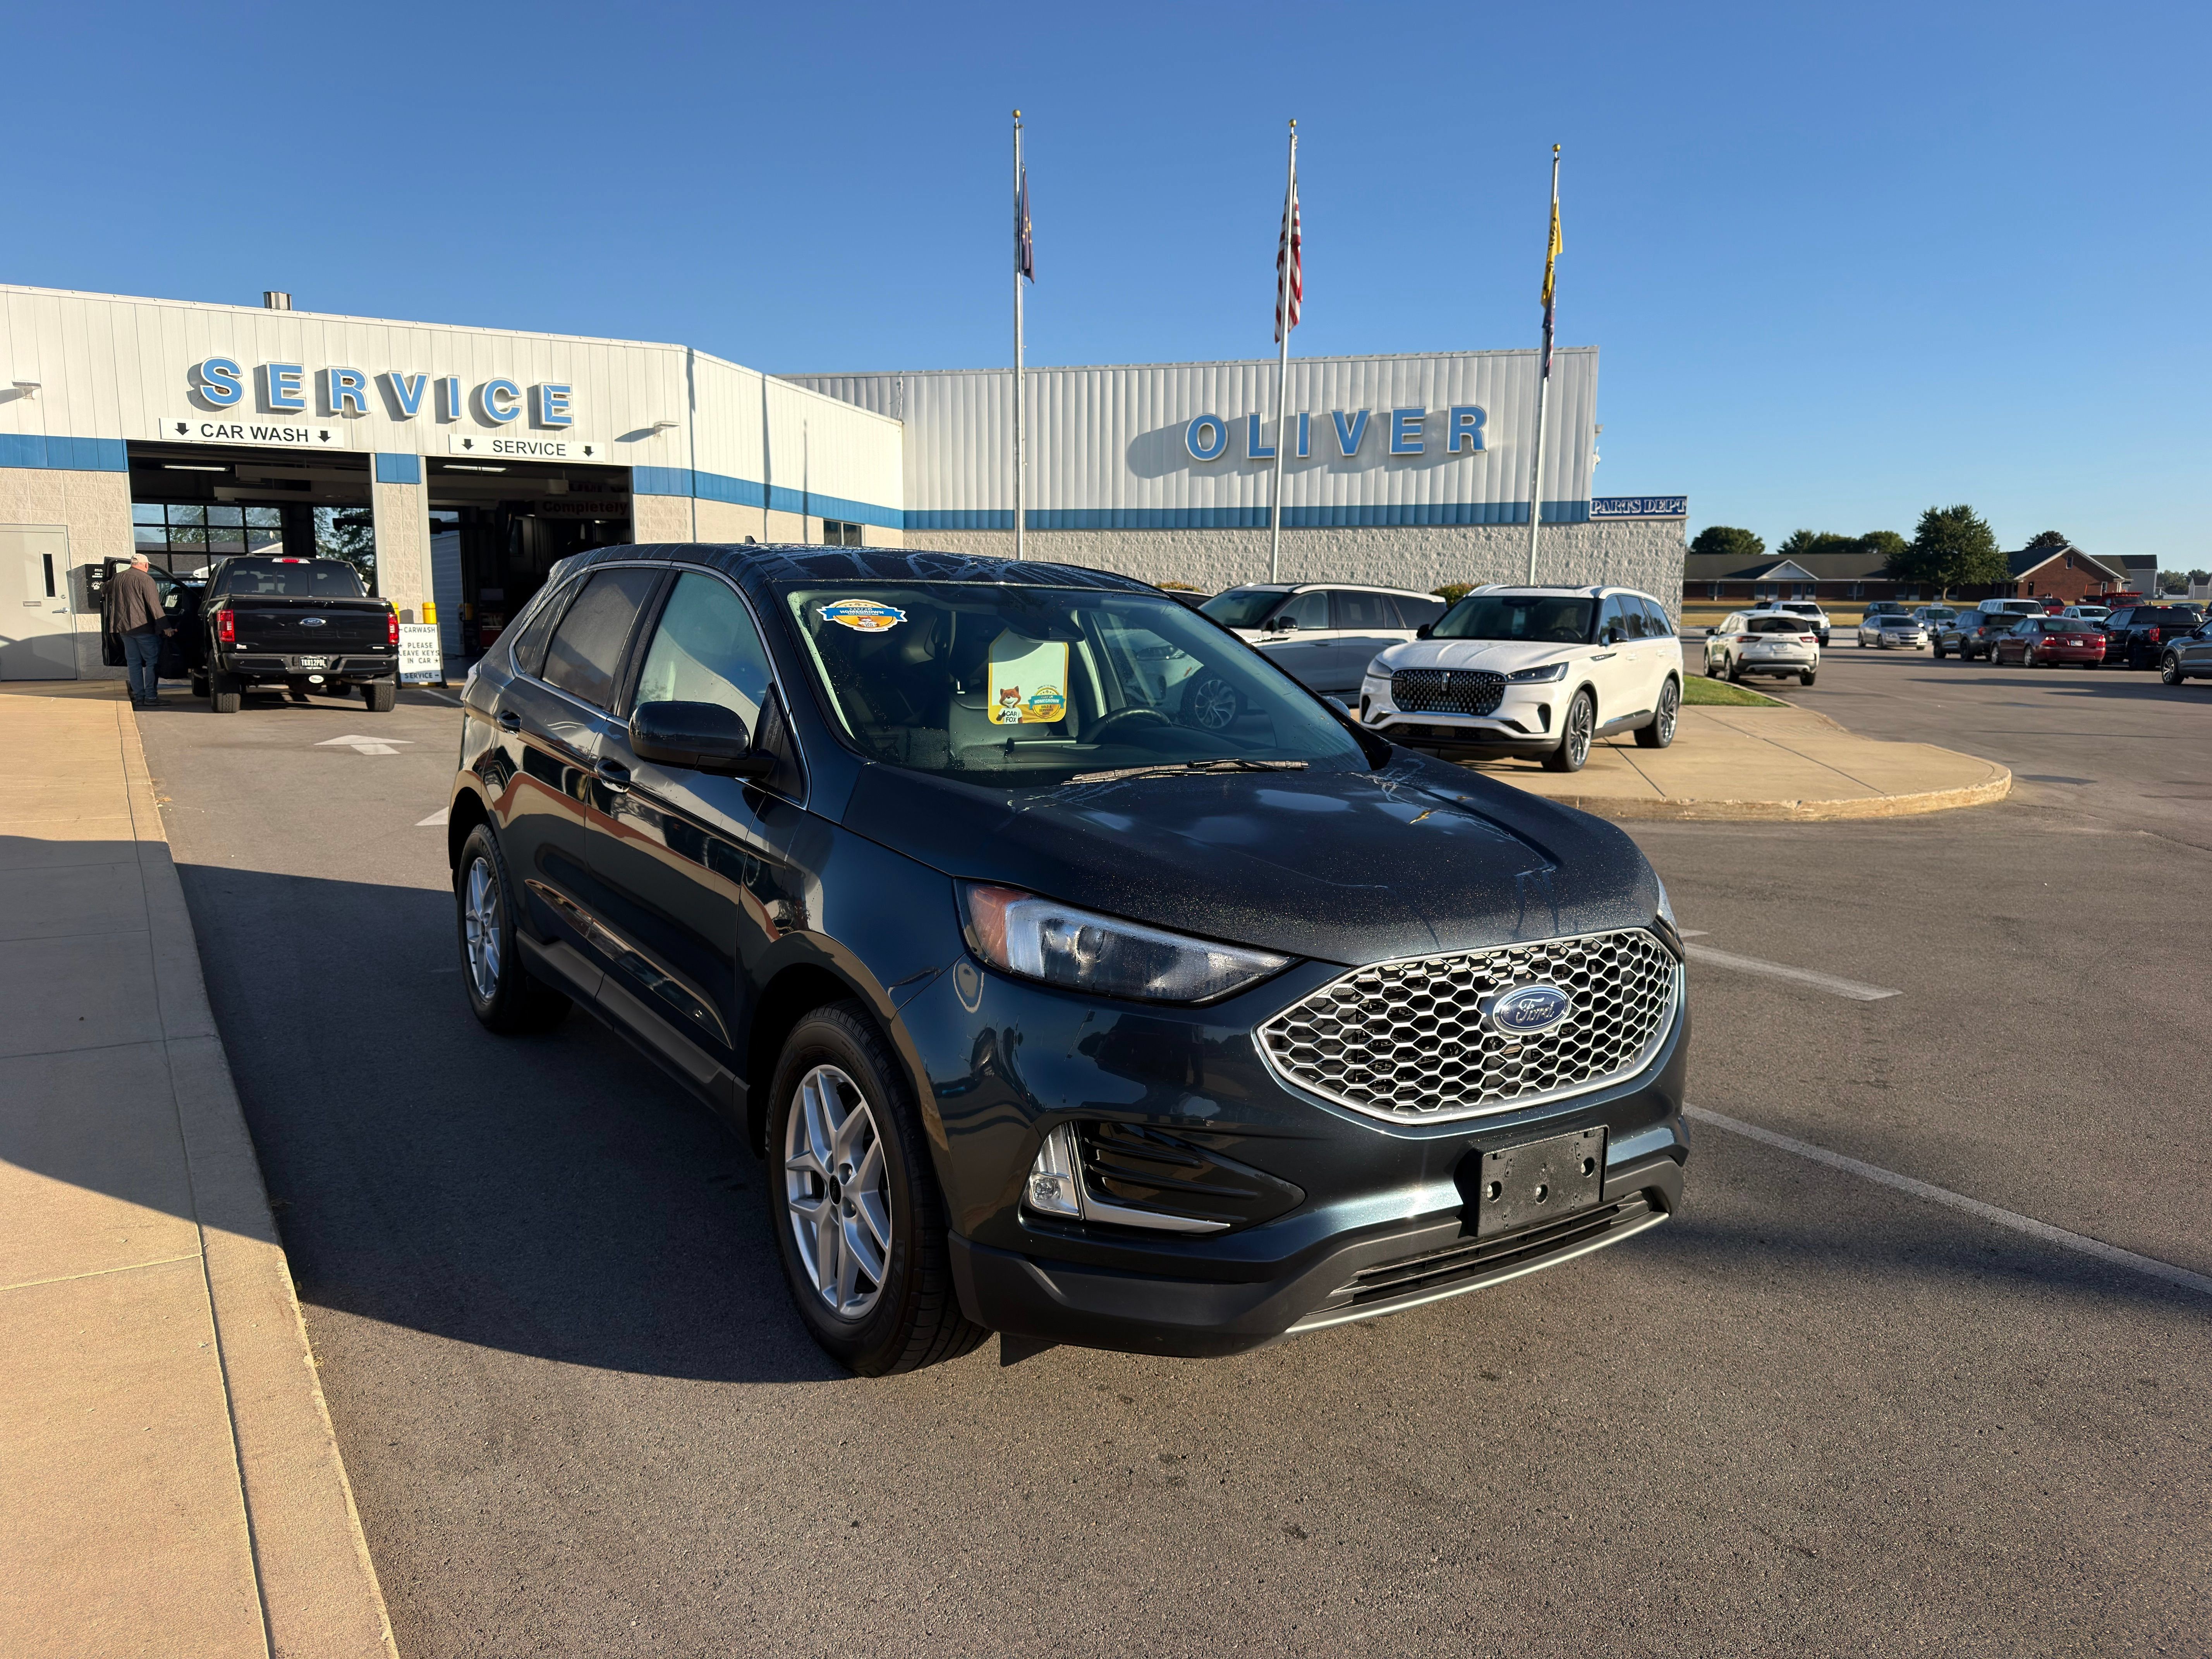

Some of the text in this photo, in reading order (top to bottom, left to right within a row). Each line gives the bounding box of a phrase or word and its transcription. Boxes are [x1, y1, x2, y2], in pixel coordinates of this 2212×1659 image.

[200, 357, 573, 426] SERVICE
[201, 424, 309, 442] CAR WASH
[1185, 405, 1487, 461] OLIVER
[493, 440, 567, 456] SERVICE
[543, 501, 628, 514] Completely
[1590, 498, 1687, 514] PARTS DEPT
[1516, 997, 1555, 1024] Ford
